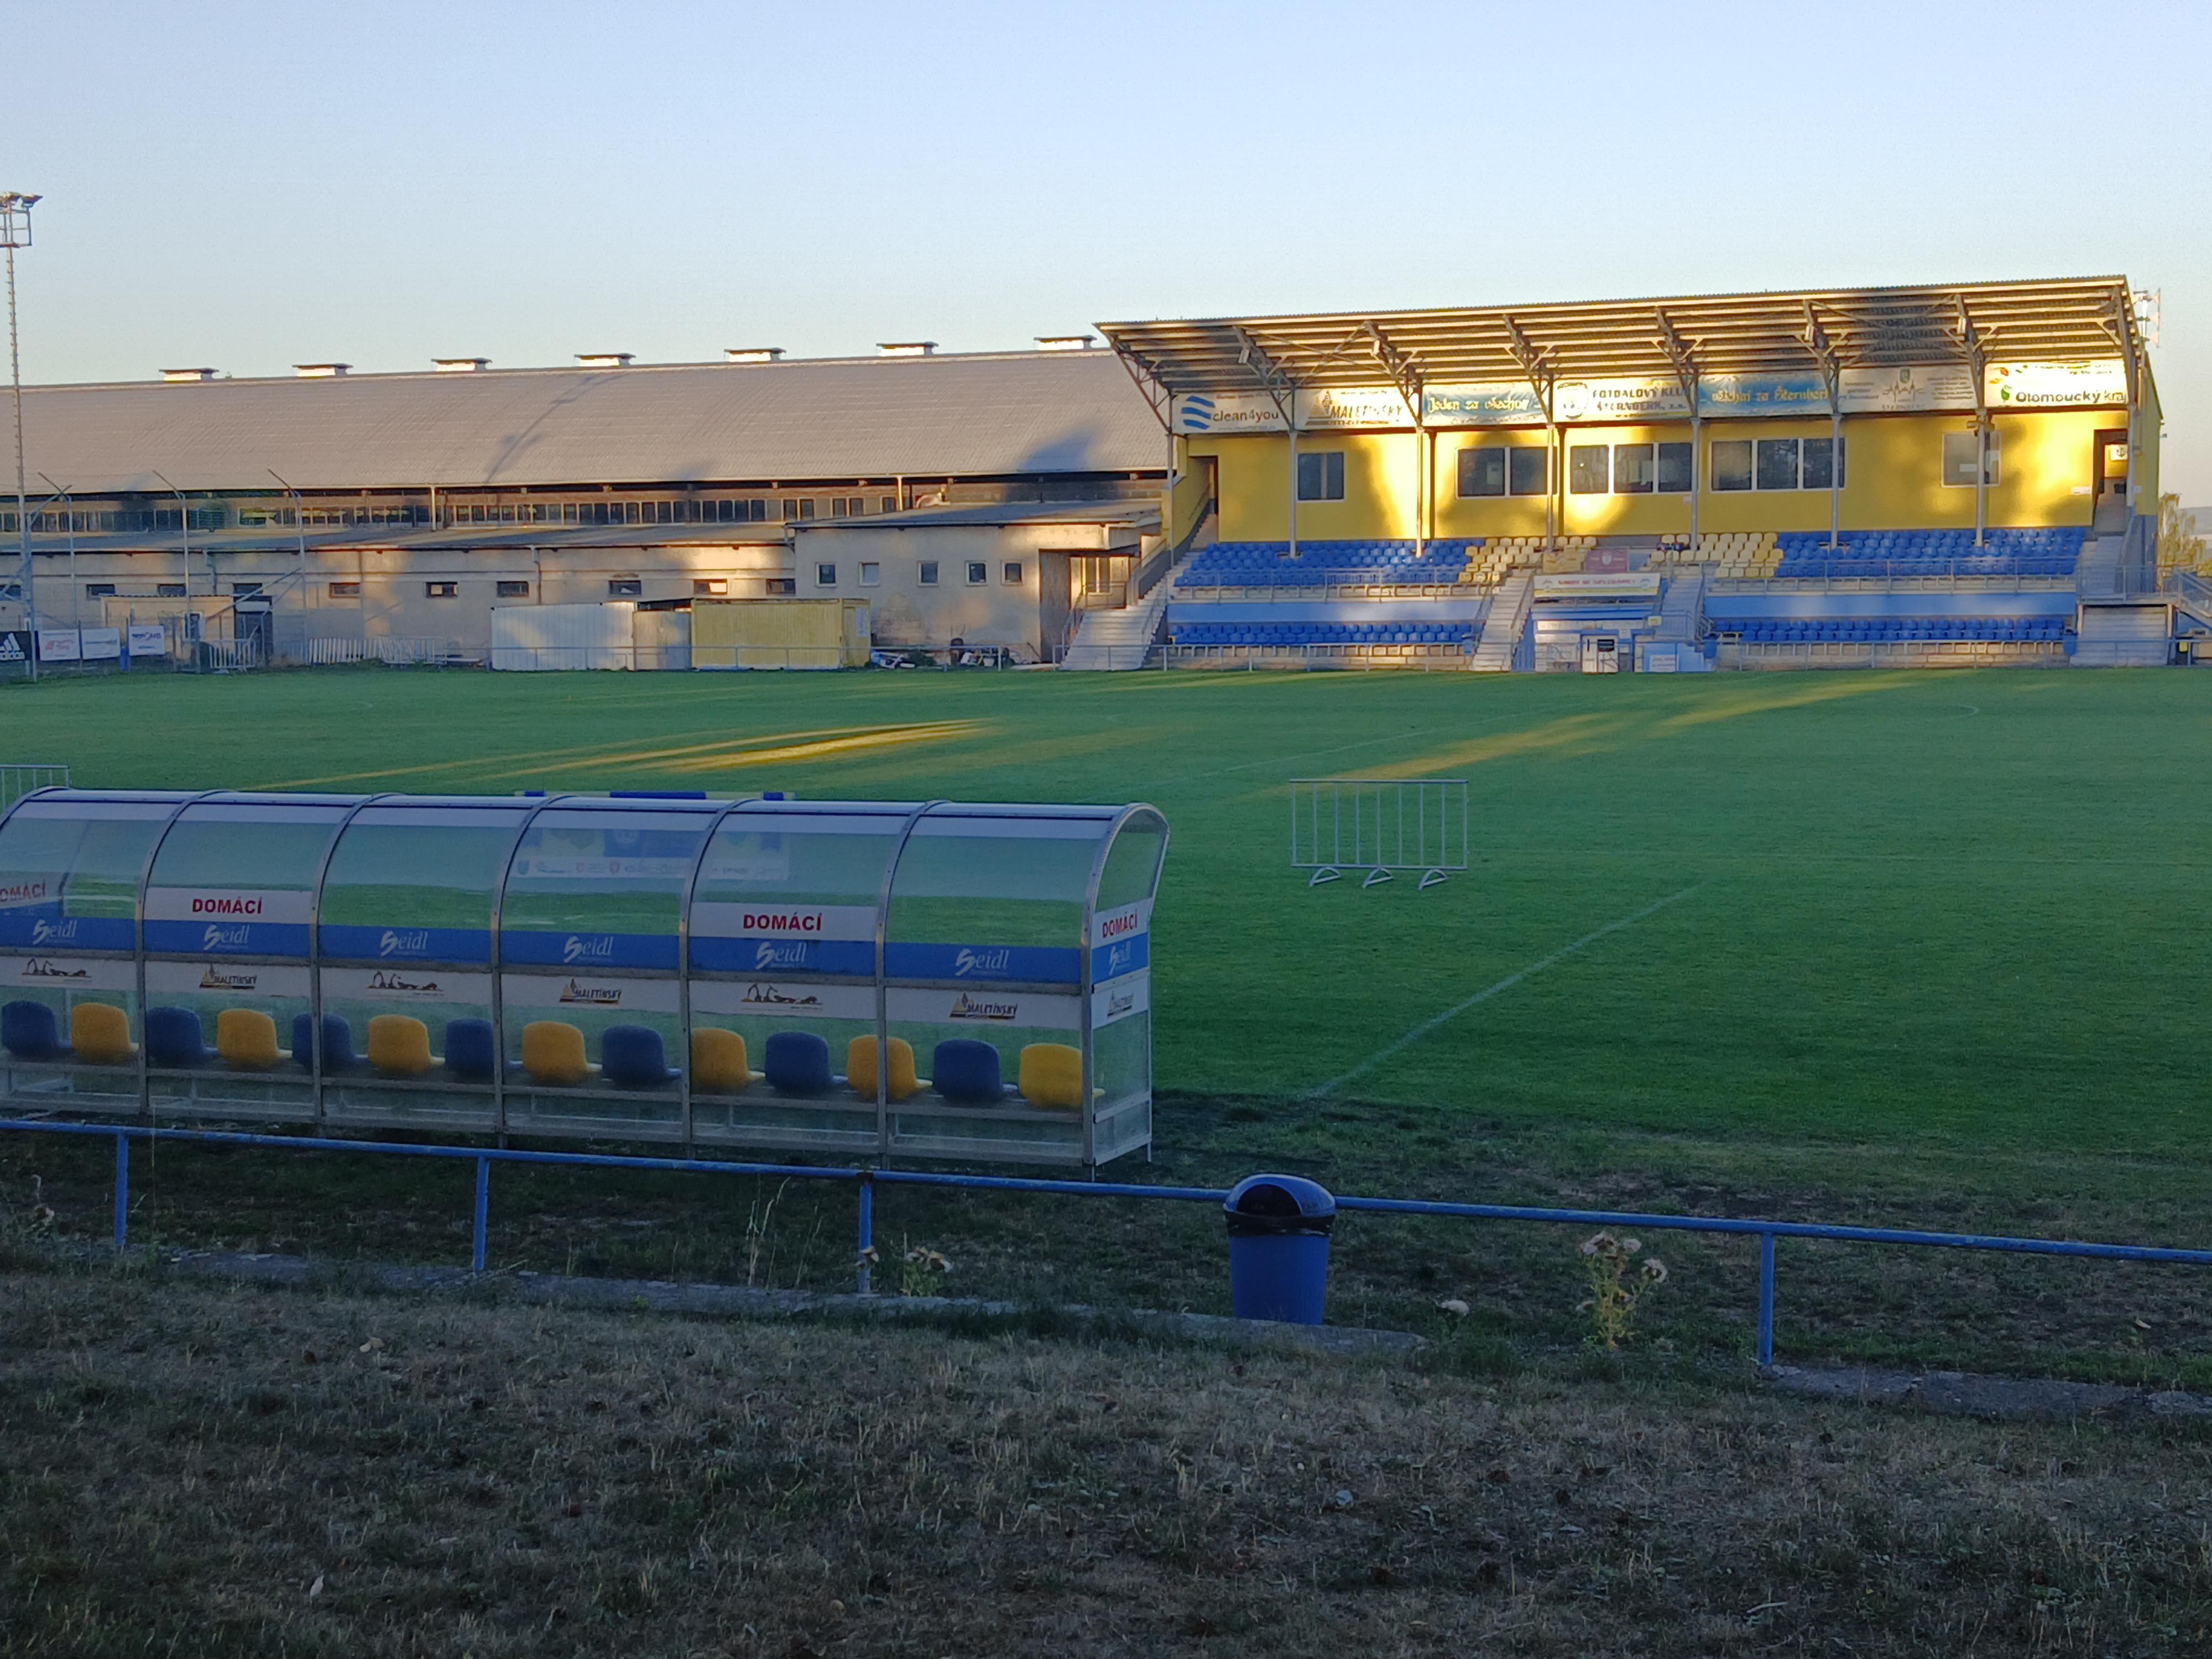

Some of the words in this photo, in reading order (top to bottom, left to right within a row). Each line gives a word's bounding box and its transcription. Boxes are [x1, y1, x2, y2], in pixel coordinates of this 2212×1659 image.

[1661, 387, 1687, 397] KLU
[2016, 390, 2101, 403] Olomoucký
[1213, 409, 1279, 423] clean4you
[0, 880, 46, 902] OMÁCÍ
[192, 896, 262, 914] DOMÁCÍ
[32, 919, 78, 945] Seidl
[743, 912, 822, 931] DOMÁCÍ
[1102, 909, 1138, 938] DOMÁCÍ
[203, 924, 250, 951] Seidl
[380, 930, 429, 957] Seidl
[563, 935, 614, 963] Seidl
[755, 941, 807, 970] Seidl
[954, 948, 1009, 977] Seidl
